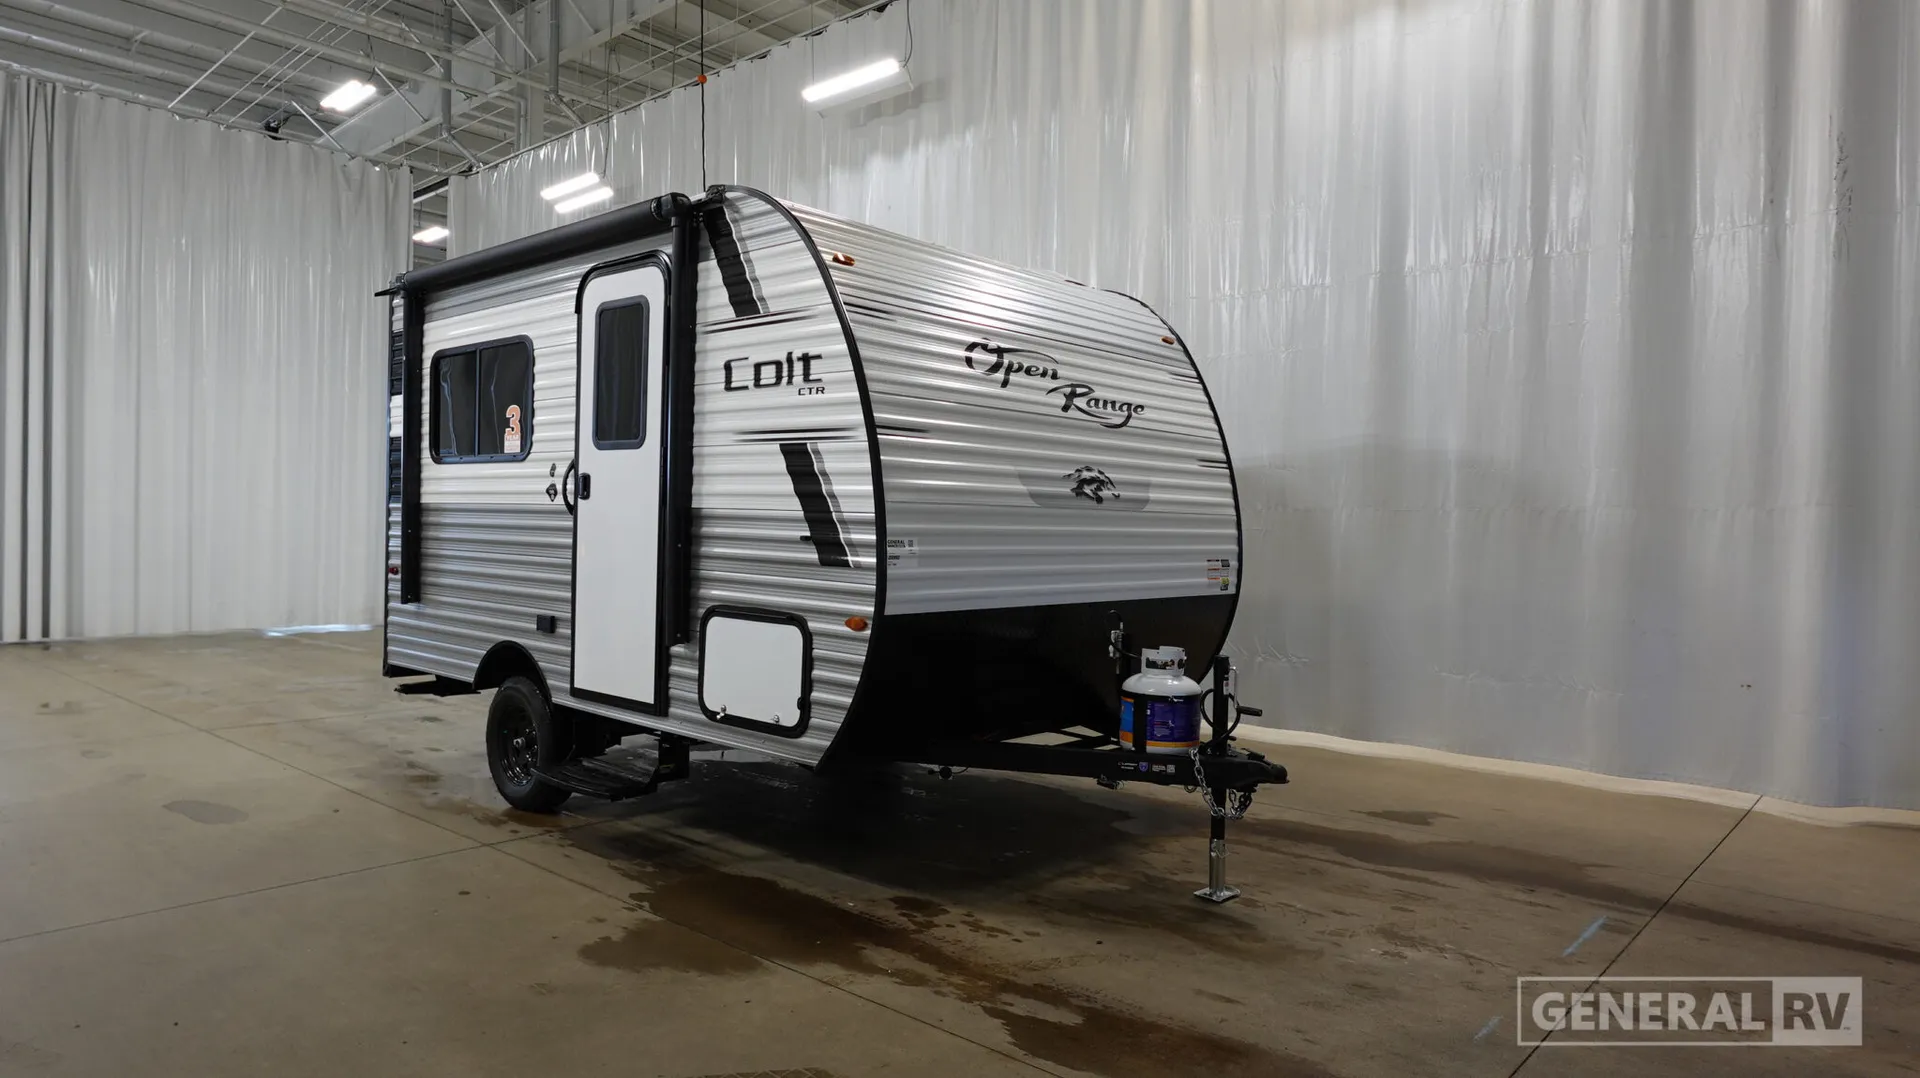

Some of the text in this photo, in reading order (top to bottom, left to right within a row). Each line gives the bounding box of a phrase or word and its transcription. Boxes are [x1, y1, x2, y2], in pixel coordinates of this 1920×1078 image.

[723, 351, 823, 392] Colt
[964, 337, 1061, 388] Open
[797, 386, 826, 396] CTR
[1045, 383, 1145, 429] Range
[505, 404, 520, 435] 3
